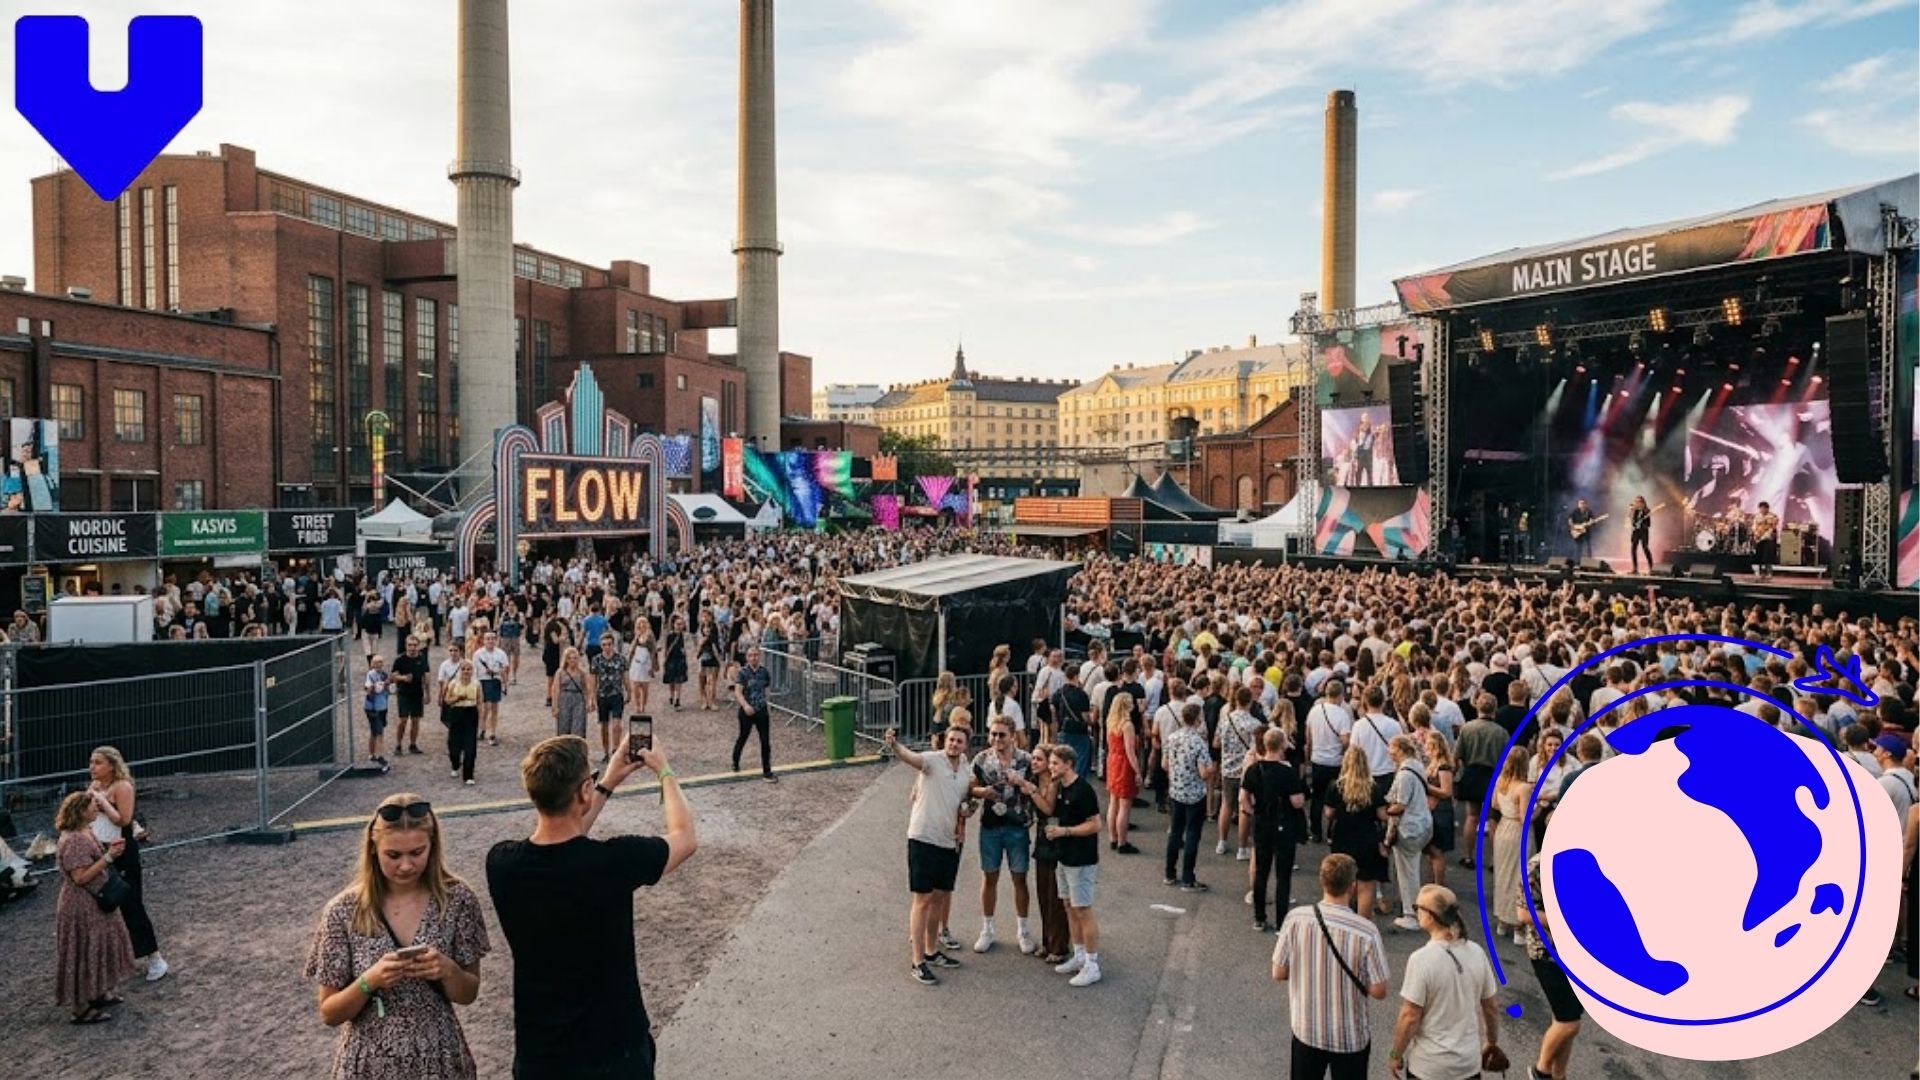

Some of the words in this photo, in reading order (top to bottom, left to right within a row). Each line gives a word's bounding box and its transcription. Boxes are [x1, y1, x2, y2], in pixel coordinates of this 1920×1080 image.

[1512, 257, 1572, 292] MAIN
[1580, 242, 1657, 281] STAGE
[526, 467, 642, 522] FLOW
[69, 519, 126, 536] NORDIC
[191, 518, 238, 535] KASVIS
[291, 513, 335, 530] STREET
[67, 537, 128, 554] CUISINE
